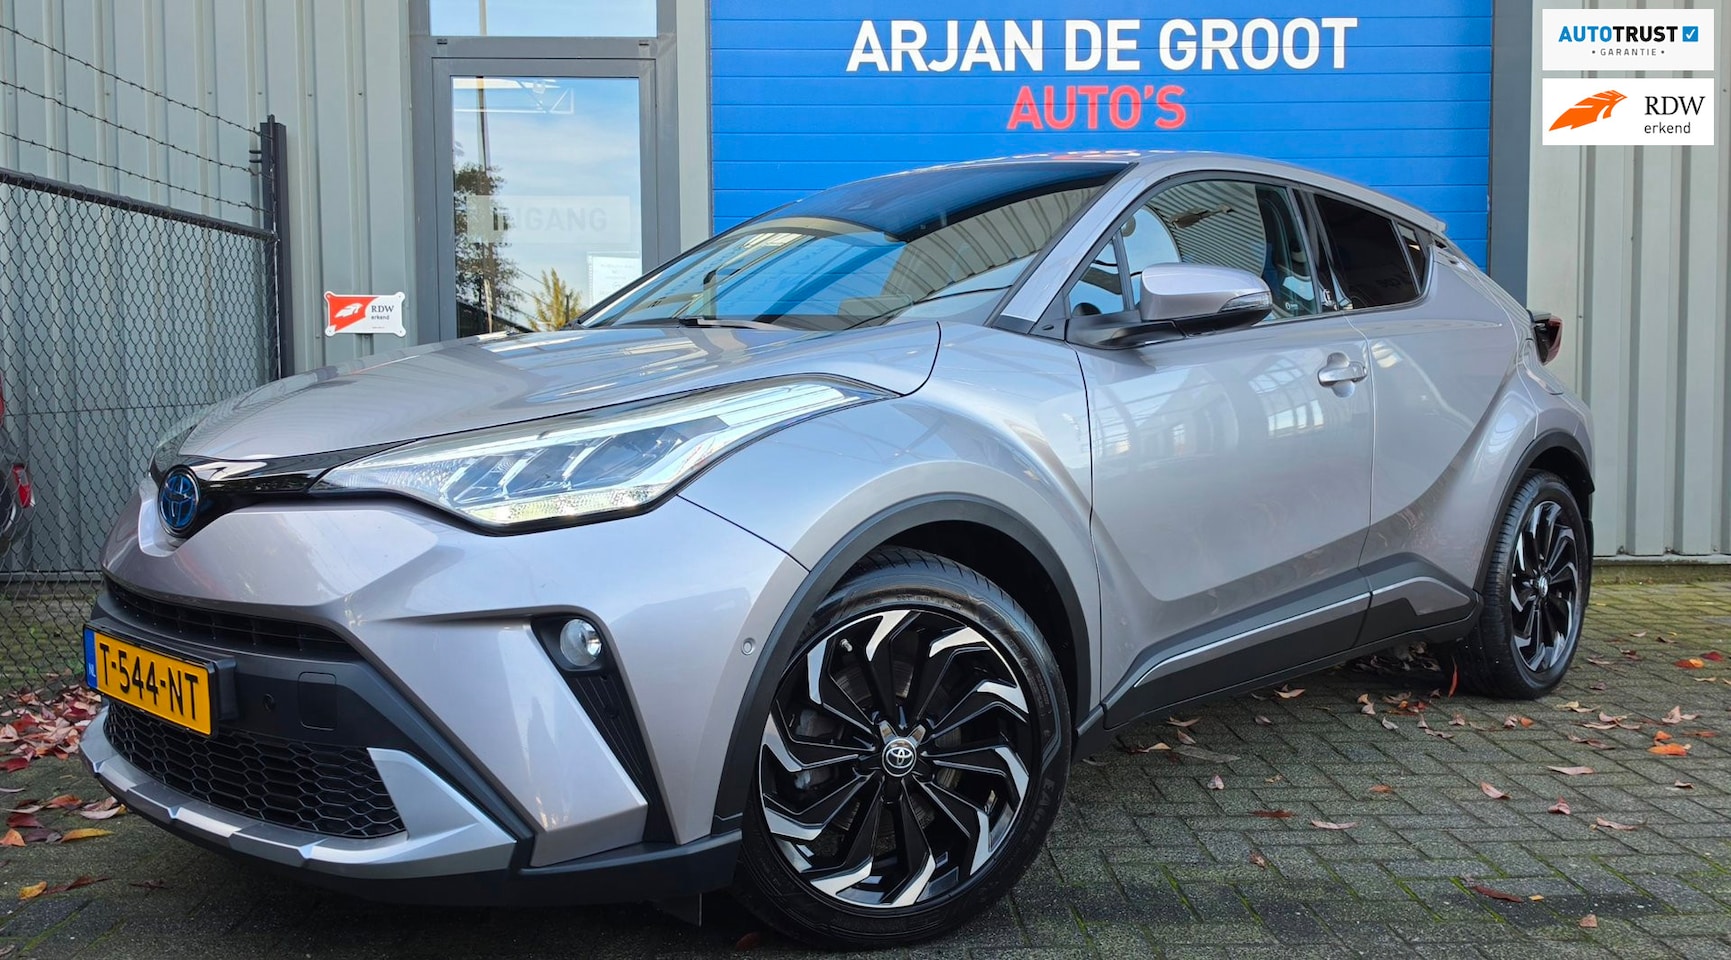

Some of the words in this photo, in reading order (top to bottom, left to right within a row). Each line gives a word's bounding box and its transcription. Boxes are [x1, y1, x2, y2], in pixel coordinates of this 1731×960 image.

[846, 19, 1044, 73] ARJAN
[1064, 19, 1141, 72] DE
[1158, 17, 1359, 71] GROOT
[1006, 85, 1187, 130] AUTO'S
[371, 305, 395, 313] RDW
[88, 662, 97, 678] NL
[99, 642, 199, 721] T-544-NT
